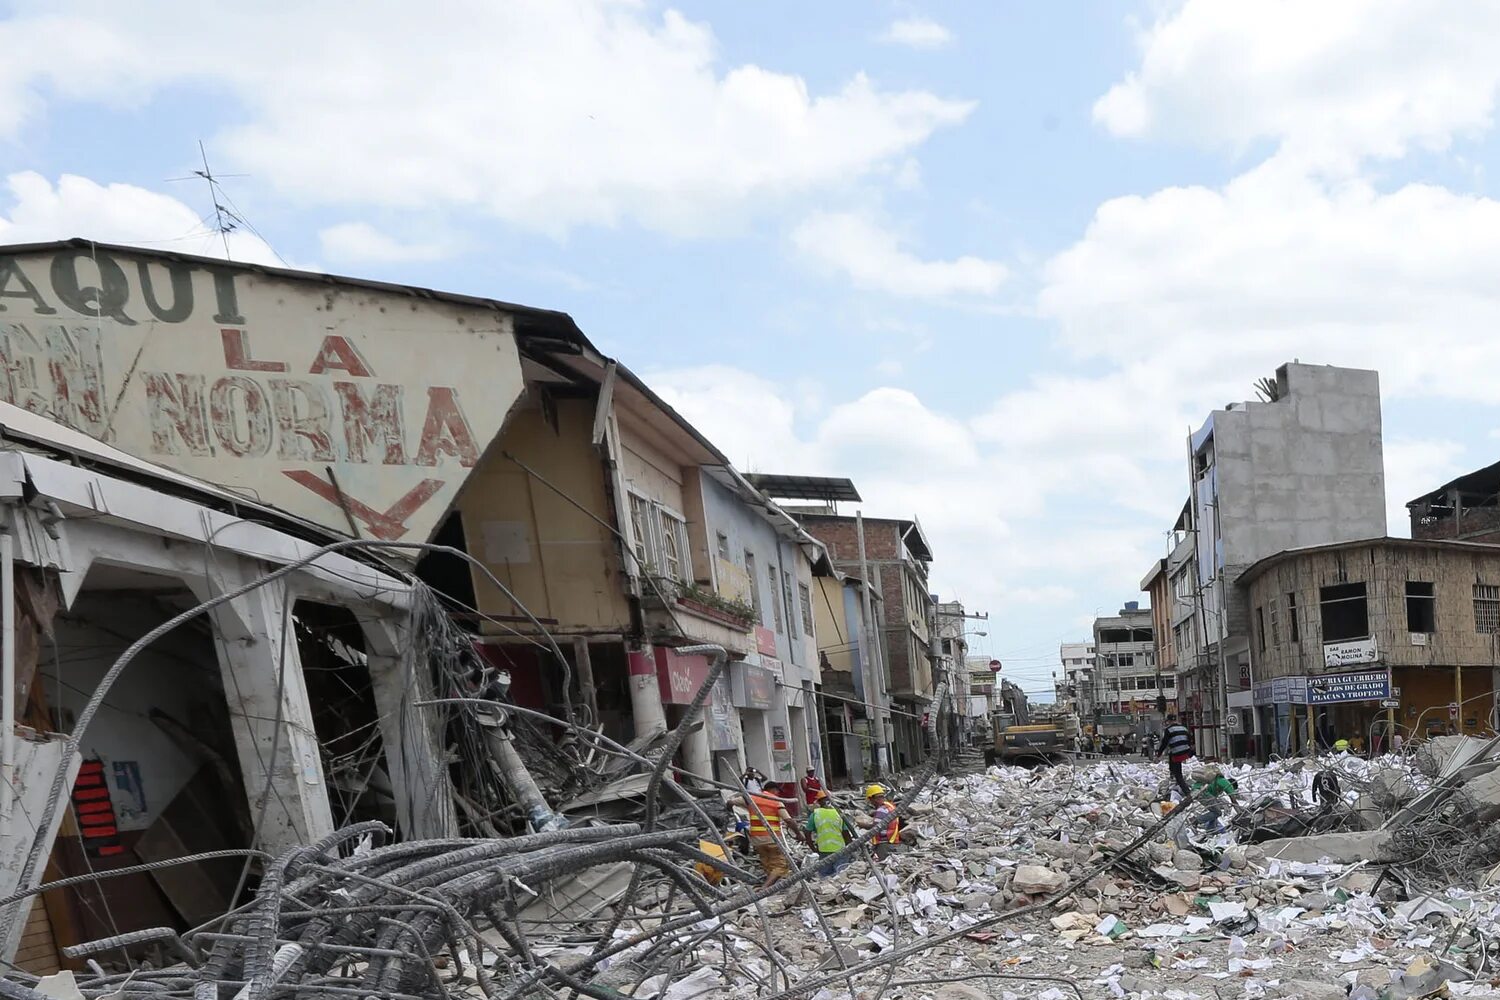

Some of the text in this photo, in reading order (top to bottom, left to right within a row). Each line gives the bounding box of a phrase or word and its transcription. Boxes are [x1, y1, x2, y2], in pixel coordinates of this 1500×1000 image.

[0, 250, 246, 326] AQUI
[220, 327, 377, 379] LA
[140, 370, 483, 468] NORMA
[1342, 674, 1387, 682] GUERRERO
[1356, 682, 1384, 690] GRADO
[1312, 693, 1340, 701] PLACAS
[1346, 690, 1384, 698] TROFEOS
